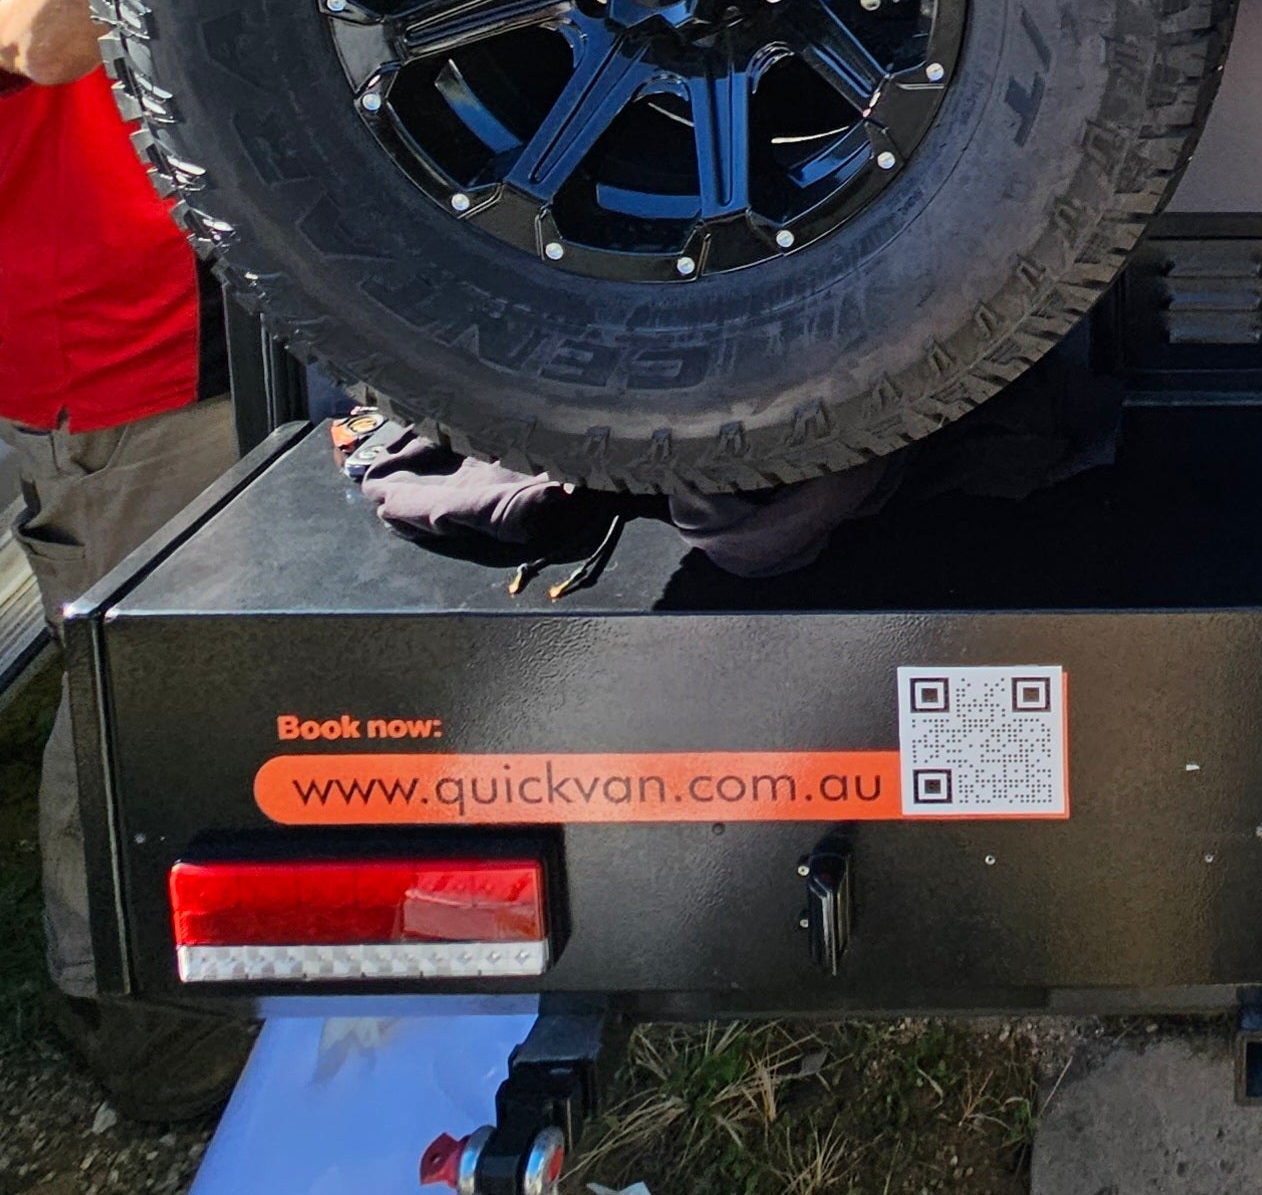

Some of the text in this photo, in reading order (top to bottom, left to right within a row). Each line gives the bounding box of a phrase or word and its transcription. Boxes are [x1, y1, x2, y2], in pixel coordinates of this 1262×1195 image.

[277, 715, 442, 740] Book now:
[293, 761, 883, 817] www.quickvan.com.au
